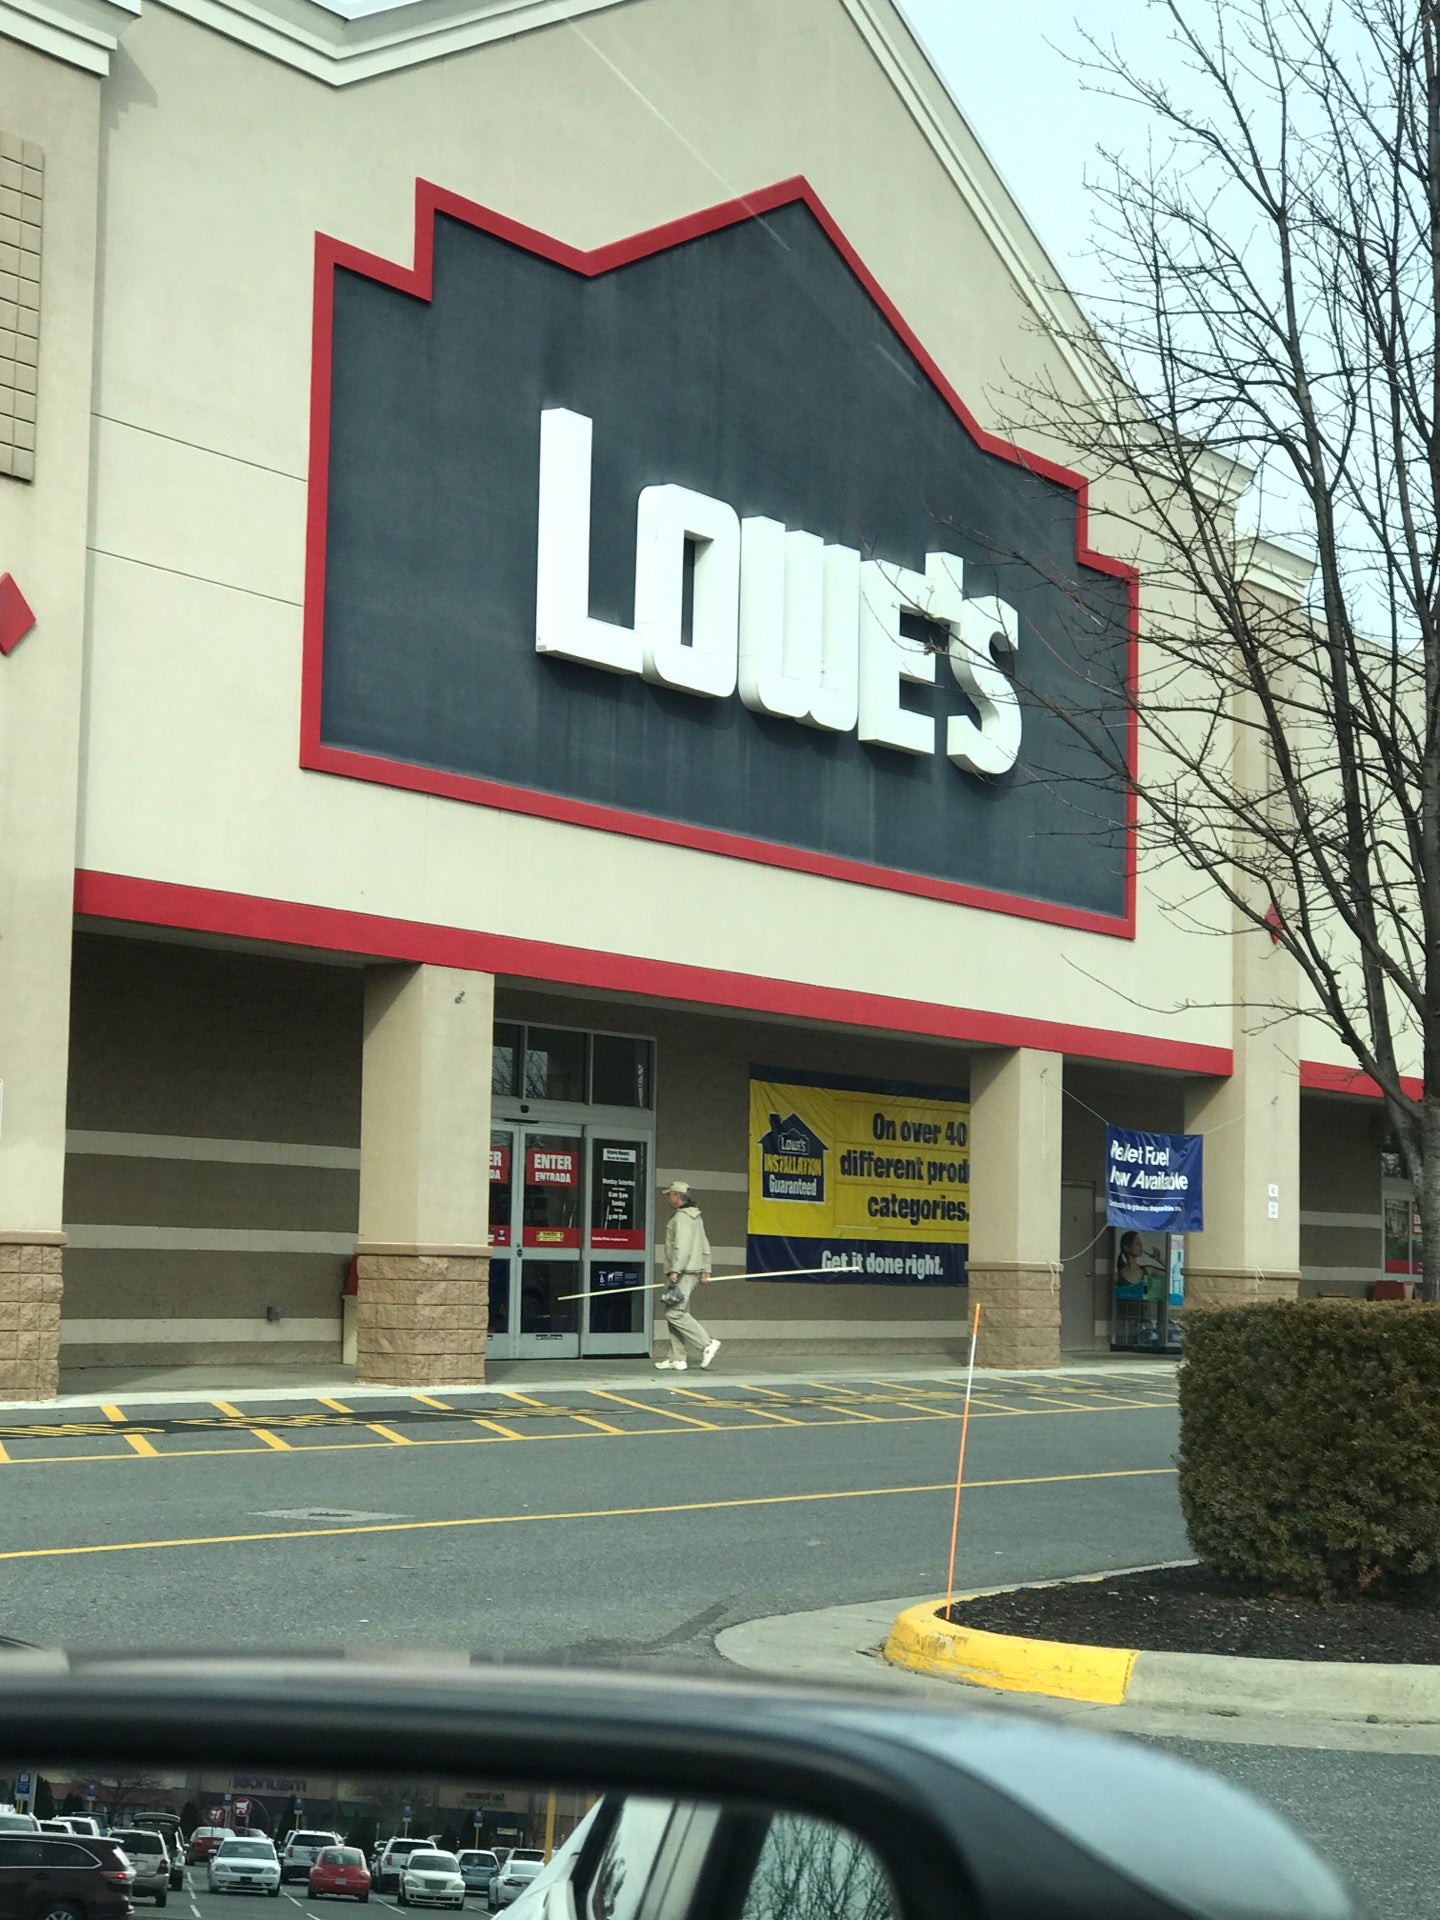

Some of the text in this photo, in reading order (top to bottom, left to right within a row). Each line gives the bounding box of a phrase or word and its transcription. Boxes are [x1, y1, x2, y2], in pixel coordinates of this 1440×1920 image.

[535, 407, 1022, 774] LOWE'S
[873, 1113, 967, 1147] On over 40
[534, 1153, 572, 1170] ENTER
[764, 1153, 822, 1177] INSTALLATION
[1110, 1139, 1169, 1166] Pelet Fuel
[535, 1172, 571, 1183] ENTRADA
[840, 1150, 969, 1184] different prod
[1131, 1170, 1188, 1191] Available
[769, 1174, 817, 1196] Guaranteed
[867, 1193, 969, 1225] categories.
[822, 1250, 944, 1280] Get it done right.
